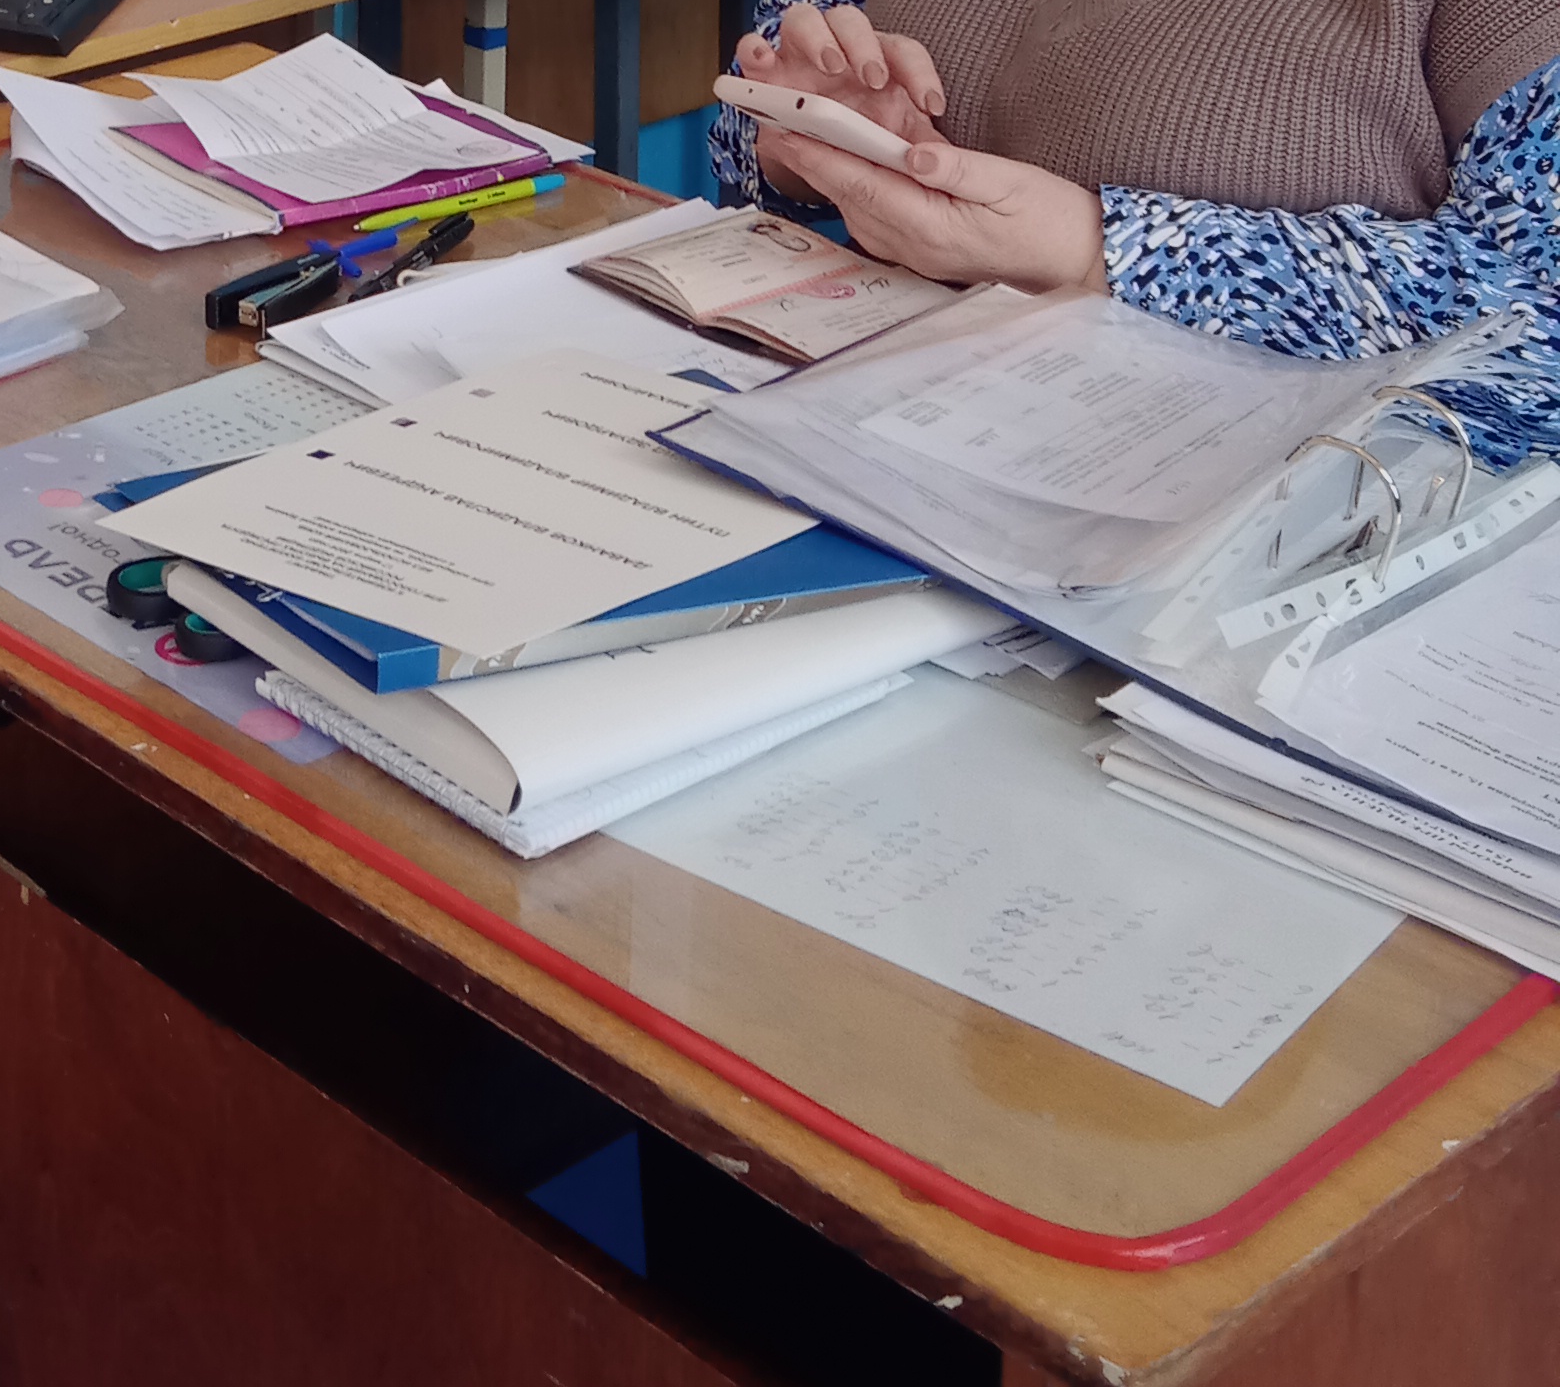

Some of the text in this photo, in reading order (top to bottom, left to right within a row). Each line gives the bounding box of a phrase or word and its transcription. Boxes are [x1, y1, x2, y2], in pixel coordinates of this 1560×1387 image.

[338, 458, 448, 498] АНДРЕЕВИЧ
[428, 428, 737, 538] ПУТИН ВЛАДИМИР ВЛАДИМИРОВИЧ
[436, 492, 555, 535] ВЛАДИСЛАВ
[543, 530, 658, 571] ДАВАНКОВ
